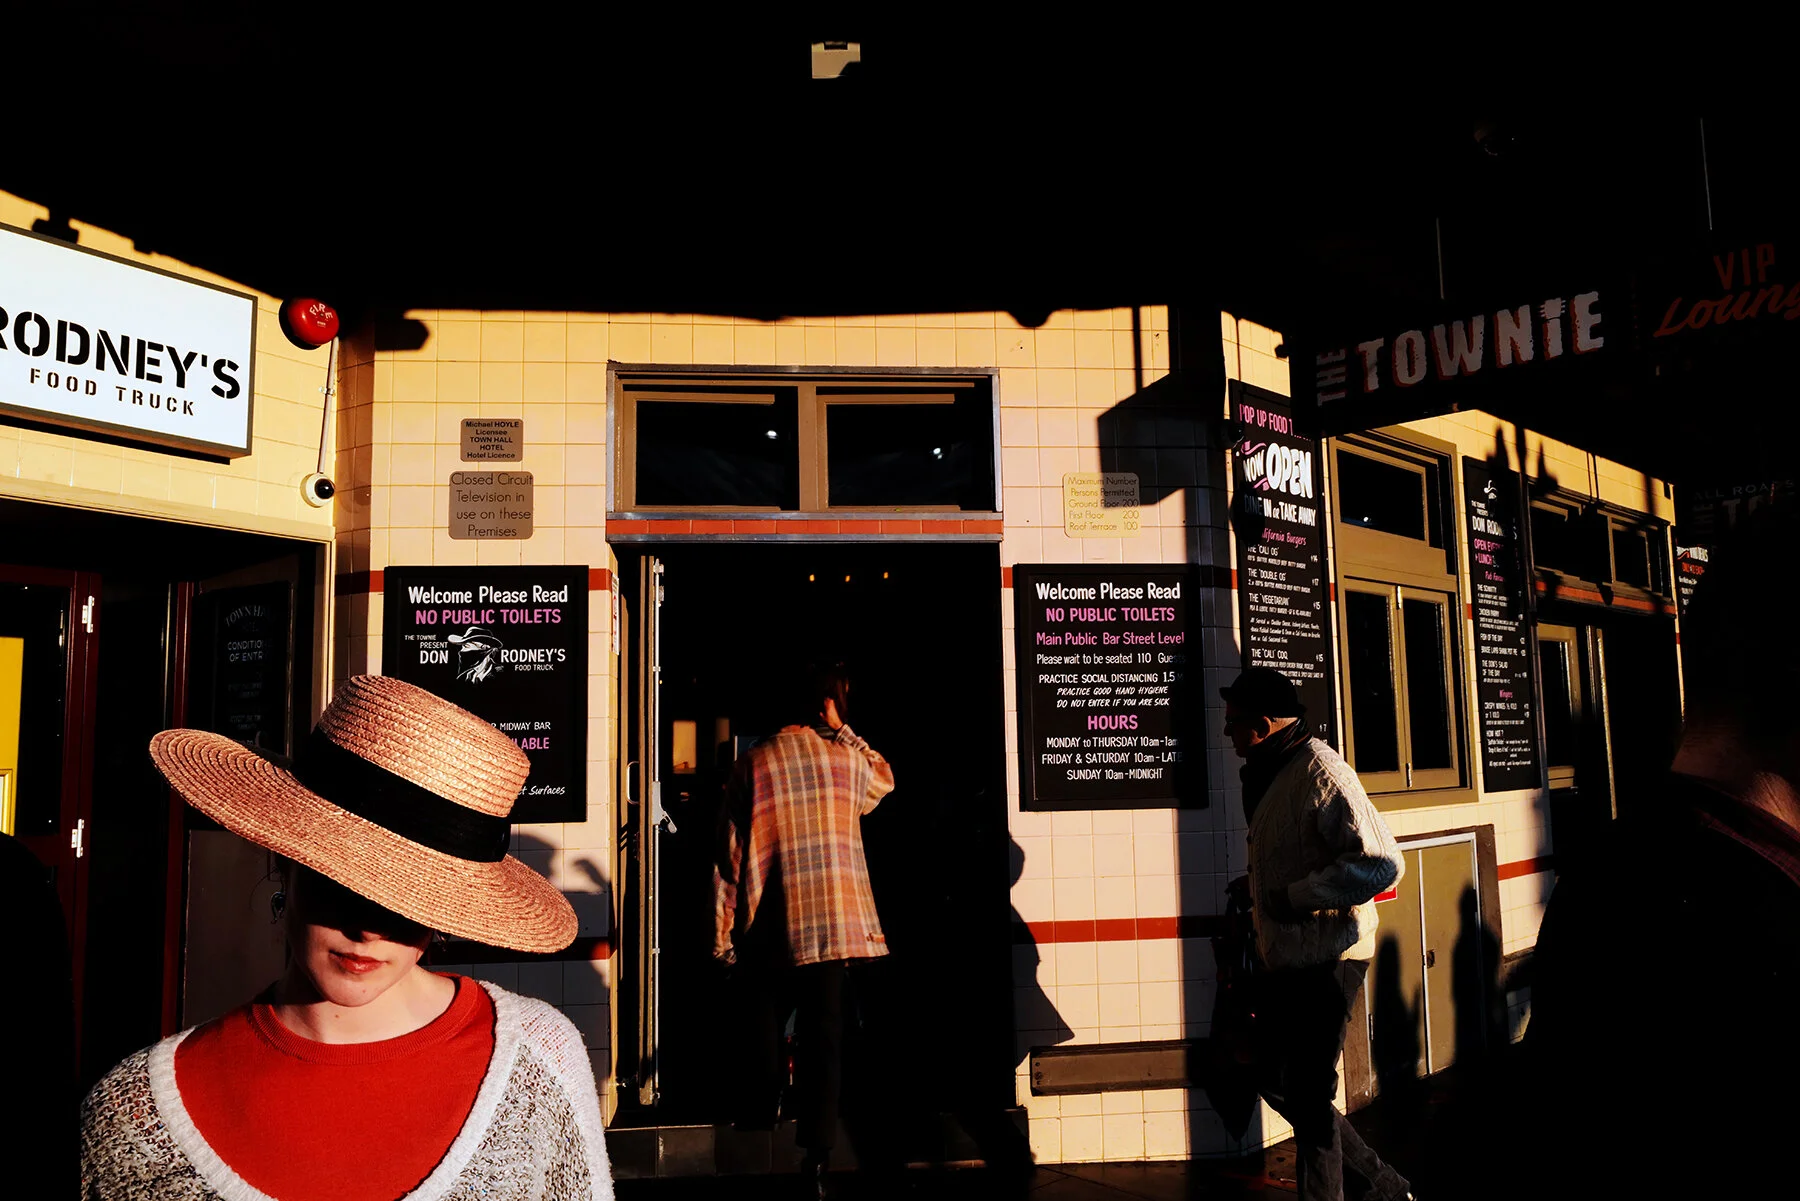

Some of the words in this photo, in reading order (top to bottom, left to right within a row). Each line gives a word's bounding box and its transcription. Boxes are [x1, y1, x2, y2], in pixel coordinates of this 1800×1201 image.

[1713, 243, 1775, 290] VIP
[309, 303, 333, 319] FIRE
[1653, 280, 1800, 337] Loung
[0, 306, 241, 399] ODNEY'S
[1316, 348, 1346, 408] THE
[1355, 290, 1604, 393] TOWNIE
[30, 368, 97, 396] FOOD
[116, 386, 194, 416] TRUCK
[1256, 408, 1267, 428] UP
[1268, 412, 1288, 435] FOOD
[1243, 450, 1265, 482] NOW
[1266, 442, 1314, 499] OPEN
[451, 472, 493, 486] Closed
[497, 472, 533, 486] Circuit
[1068, 477, 1104, 485] Maximum
[1106, 476, 1137, 485] Number
[456, 490, 511, 502] Television
[515, 492, 525, 502] in
[1070, 488, 1098, 496] Persons
[1101, 487, 1135, 496] Permitted
[1068, 499, 1098, 508] Ground
[1101, 499, 1120, 508] Floor
[1122, 499, 1138, 508] 200
[456, 511, 476, 520] use
[480, 511, 495, 520] on
[499, 507, 531, 520] these
[1069, 511, 1083, 519] First
[1085, 510, 1104, 519] Floor
[1123, 510, 1140, 519] 200
[1263, 498, 1272, 518] IN
[1279, 502, 1297, 523] TAKE
[1298, 506, 1316, 527] AWAY
[467, 524, 517, 537] Premises
[1070, 522, 1087, 530] Roof
[1089, 522, 1117, 530] Terrace
[1123, 521, 1138, 530] 100
[1472, 516, 1485, 533] DON
[1261, 527, 1285, 542] lifornia
[1286, 532, 1306, 548] Burgers
[1474, 539, 1487, 551] OPEN
[1248, 568, 1257, 577] THE
[408, 586, 472, 604] Welcome
[479, 585, 528, 604] Please
[533, 584, 568, 603] Read
[1036, 582, 1096, 600] Welcome
[1100, 582, 1143, 600] Please
[1147, 581, 1180, 599] Read
[1249, 593, 1258, 603] THE
[415, 610, 437, 625] NO
[442, 609, 495, 624] PUBLIC
[500, 608, 562, 624] TOILETS
[1046, 607, 1065, 622] NO
[1070, 607, 1117, 622] PUBLIC
[1121, 607, 1175, 622] TOILETS
[1036, 632, 1062, 645] Main
[1065, 632, 1097, 645] Public
[1103, 632, 1119, 645] Bar
[1123, 631, 1155, 645] Street
[1158, 631, 1184, 644] Level
[228, 639, 264, 650] CONDITIO
[420, 641, 448, 649] PRESENT
[229, 652, 240, 662] OF
[242, 650, 264, 661] ENTR
[420, 650, 448, 664] DON
[501, 648, 566, 663] RODNEY'S
[1037, 653, 1062, 664] Please
[1064, 653, 1080, 664] wait
[1083, 654, 1092, 664] to
[1093, 653, 1103, 664] be
[1105, 653, 1132, 664] seated
[1138, 653, 1151, 663] 110
[1251, 648, 1261, 658] THE
[1039, 673, 1078, 684] PRACTICE
[1081, 673, 1109, 683] SOCIAL
[1111, 673, 1158, 683] DISTANCING
[1056, 687, 1091, 696] PRACTICE
[1093, 687, 1111, 695] GOOD
[1115, 687, 1135, 695] HAND
[1138, 686, 1168, 695] HYGIENE
[1056, 699, 1068, 708] DO
[1071, 699, 1086, 707] NOT
[1088, 699, 1110, 707] ENTER
[1112, 698, 1121, 707] IF
[1123, 698, 1136, 707] YOU
[1138, 698, 1153, 706] ARE
[1154, 698, 1170, 706] SICK
[500, 721, 531, 731] MIDWAY
[534, 721, 551, 730] BAR
[1087, 714, 1138, 730] HOURS
[1046, 737, 1081, 748] MONDAY
[1082, 739, 1091, 748] to
[1092, 736, 1138, 747] THURSDAY
[1041, 753, 1073, 764] FRIDAY
[1075, 753, 1082, 764] &
[1085, 752, 1130, 763] SATURDAY
[1066, 769, 1102, 780] SUNDAY
[528, 785, 566, 795] Surfaces
